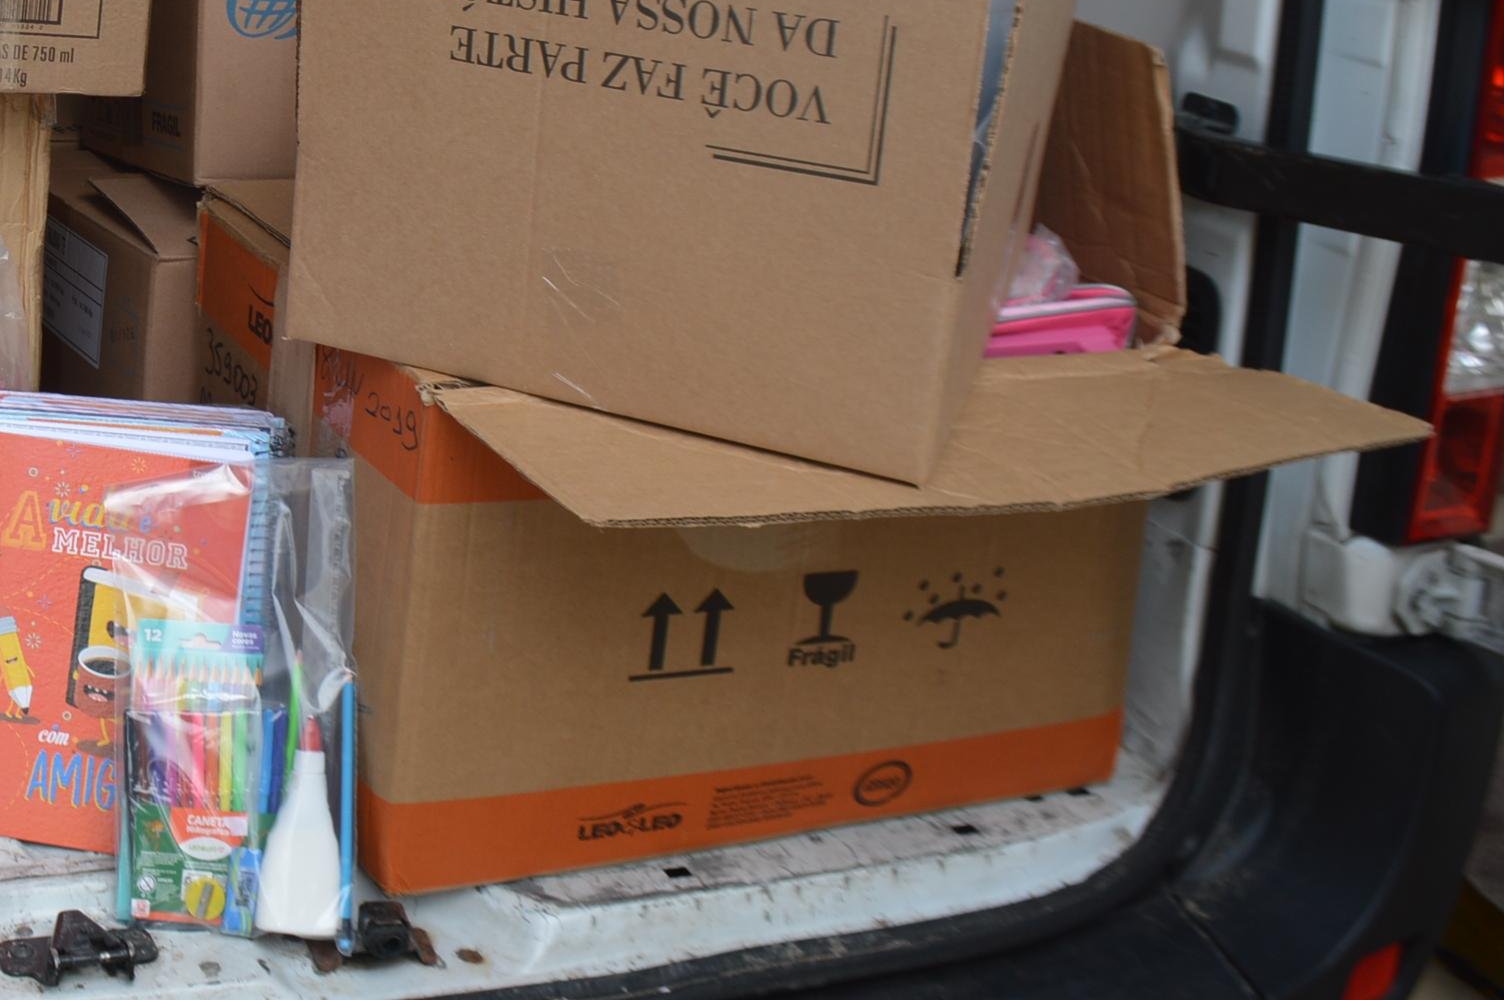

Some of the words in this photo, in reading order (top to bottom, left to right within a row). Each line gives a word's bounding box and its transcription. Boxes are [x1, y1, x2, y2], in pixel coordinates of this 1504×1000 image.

[13, 43, 29, 61] DE
[32, 45, 56, 63] 750
[59, 47, 75, 64] ml
[448, 25, 589, 84] PARTE
[772, 10, 841, 59] DA
[600, 50, 687, 101] FAZ
[700, 66, 831, 125] VOCÊ
[151, 110, 182, 138] FRAGIL
[365, 391, 418, 451] 2019
[0, 490, 46, 549] A
[52, 527, 188, 570] MELHOR
[144, 629, 162, 642] 12
[232, 630, 258, 640] Novas
[788, 643, 856, 668] Frágil
[37, 729, 70, 746] com
[26, 748, 117, 813] AMIG
